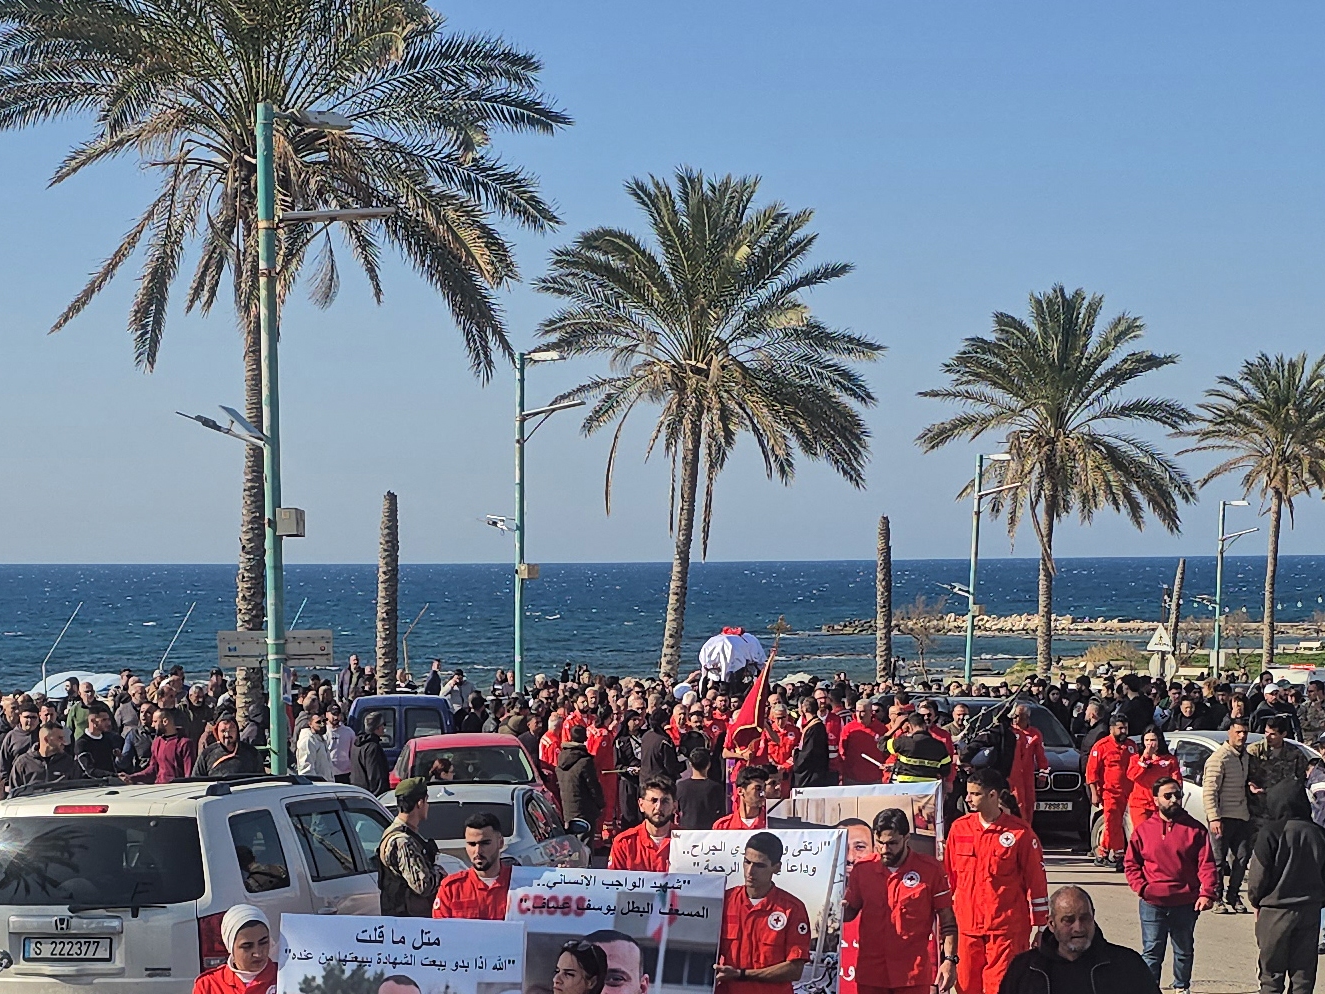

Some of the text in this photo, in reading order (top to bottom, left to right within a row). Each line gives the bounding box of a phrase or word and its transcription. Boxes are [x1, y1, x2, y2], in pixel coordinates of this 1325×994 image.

[682, 841, 726, 857] الجراح..
[692, 858, 740, 876] الرحمة."
[602, 877, 645, 891] الواجب
[650, 878, 691, 894] "شهيد
[576, 898, 616, 916] يوسف
[620, 900, 653, 917] البطل
[659, 903, 709, 919] المسعف
[355, 924, 385, 945] قلت
[391, 927, 406, 946] ما
[34, 940, 101, 957] S 222377
[318, 952, 334, 965] من
[376, 952, 416, 970] الشهادة
[450, 959, 470, 973] بدو
